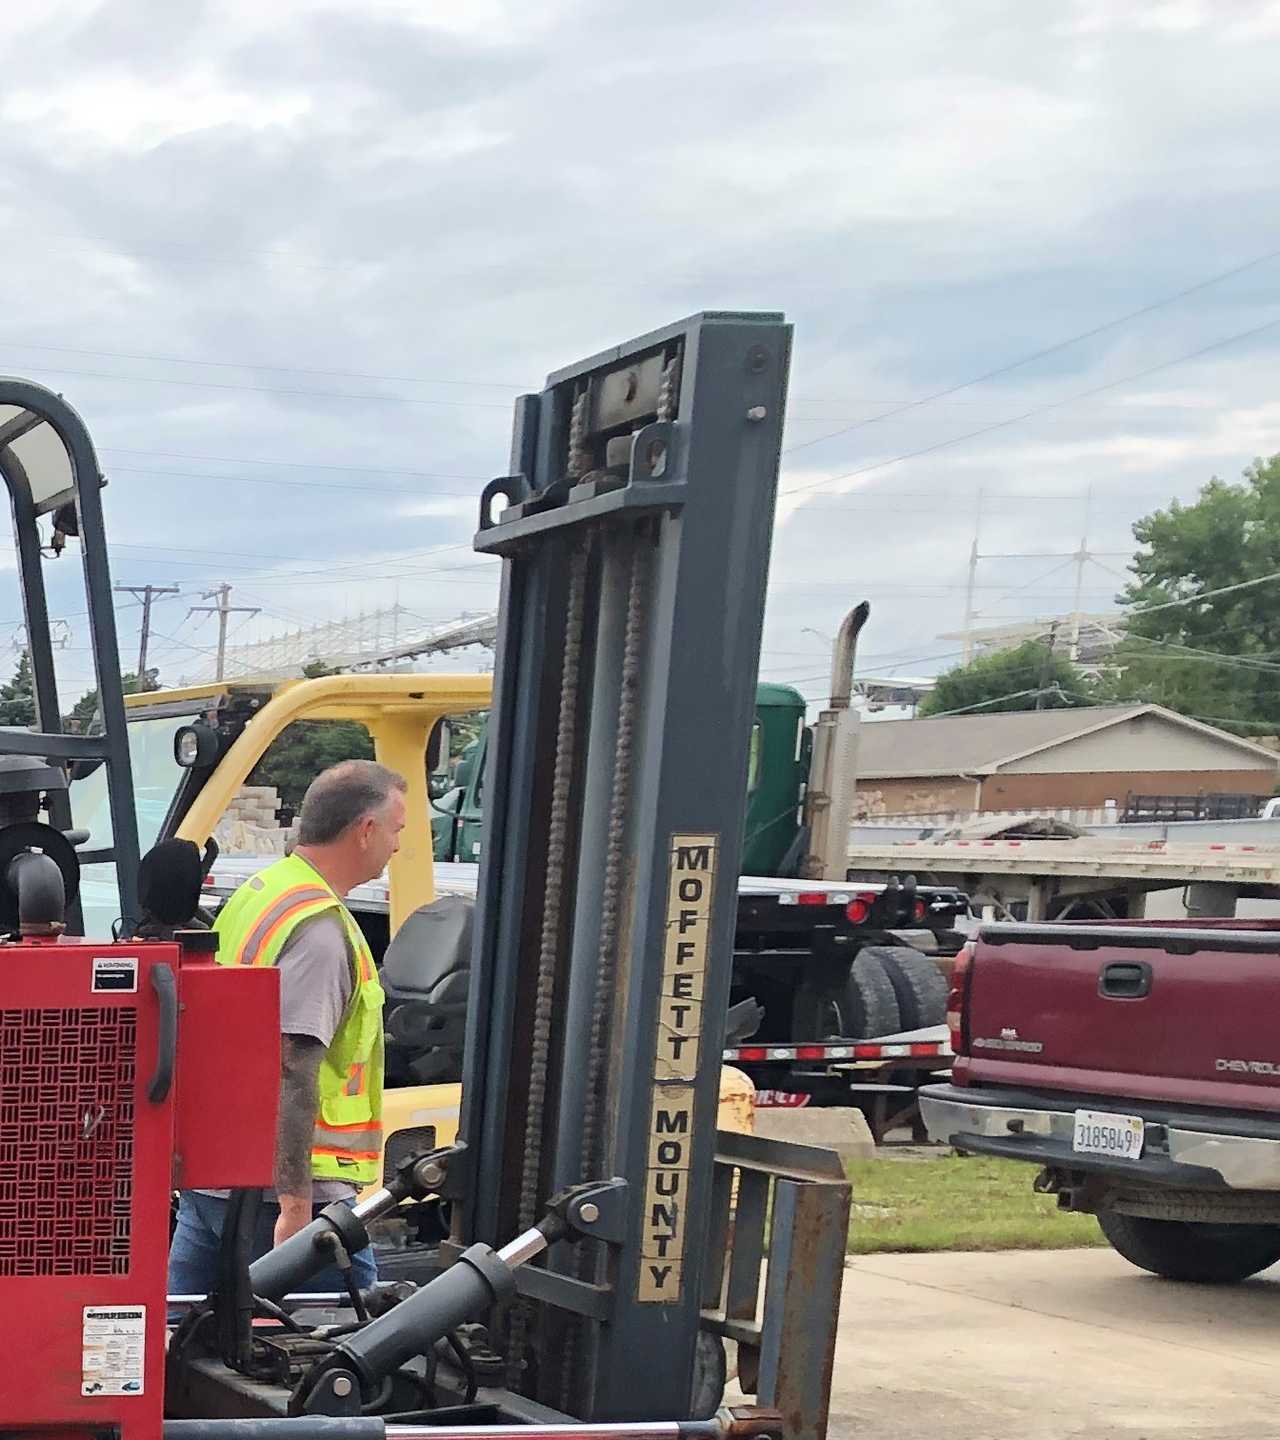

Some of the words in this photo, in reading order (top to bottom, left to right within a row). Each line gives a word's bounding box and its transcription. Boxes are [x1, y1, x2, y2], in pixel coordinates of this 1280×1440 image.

[668, 845, 708, 1060] MOFFETT
[649, 1109, 687, 1290] MOUNTY
[1077, 1124, 1133, 1153] 3185849
